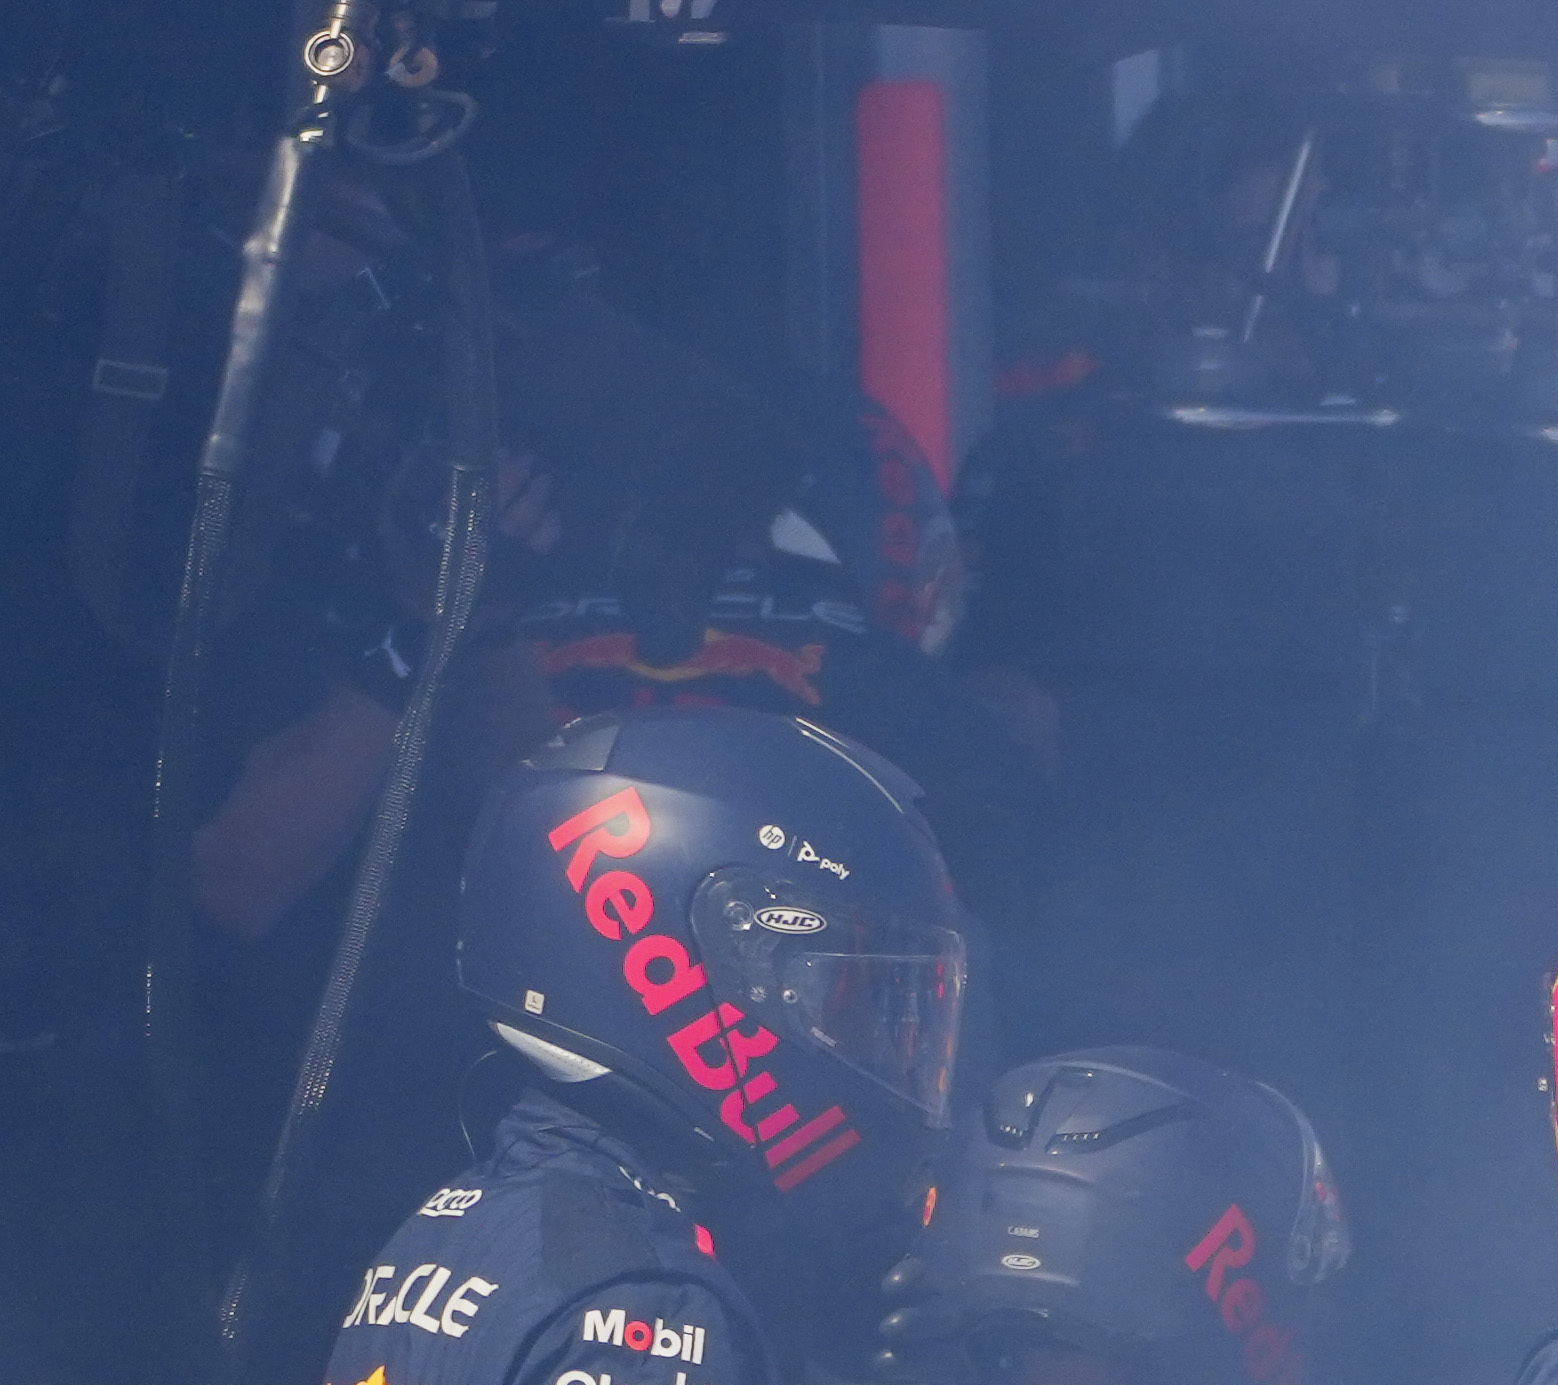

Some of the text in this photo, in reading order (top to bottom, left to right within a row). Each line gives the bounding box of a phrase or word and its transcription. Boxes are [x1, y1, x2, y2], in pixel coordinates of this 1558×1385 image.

[820, 857, 850, 880] poly
[764, 911, 815, 928] HJC
[548, 786, 862, 1193] Red Bull
[582, 1308, 706, 1365] Mobil
